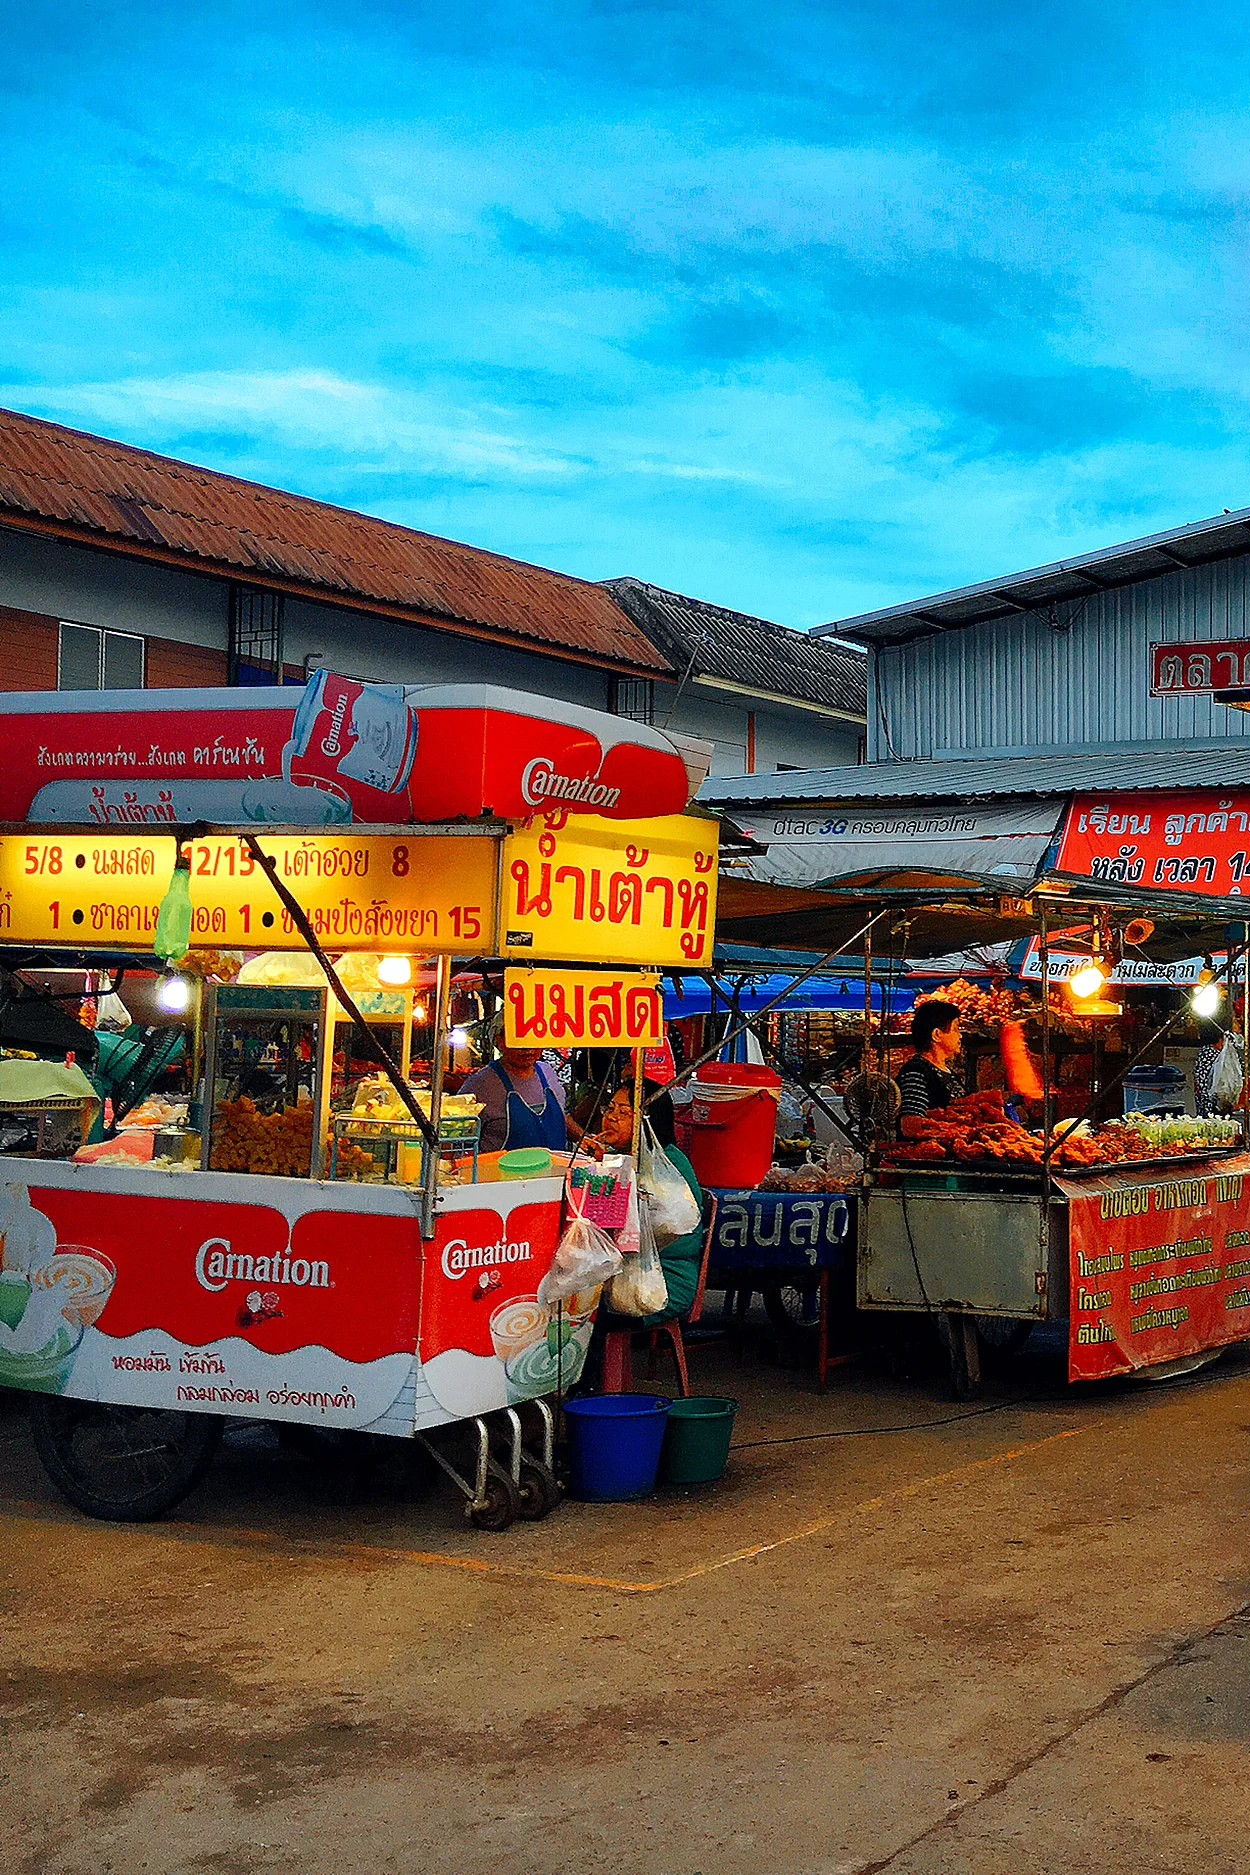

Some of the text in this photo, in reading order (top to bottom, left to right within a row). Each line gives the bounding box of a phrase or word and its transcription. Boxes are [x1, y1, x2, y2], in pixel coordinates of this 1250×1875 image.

[320, 693, 348, 757] Carnation
[521, 757, 621, 808] Carnation
[773, 817, 818, 836] dtac
[819, 818, 848, 835] 3G
[1078, 805, 1150, 835] เรียน
[25, 846, 63, 875] 5/8
[92, 847, 156, 875] นมสด
[284, 841, 369, 877] เต้าฮวย
[391, 845, 410, 877] 8
[1153, 857, 1215, 882] เวลา
[511, 806, 714, 959] น้ำเต้าหู้
[48, 901, 60, 929] 1
[238, 903, 251, 933] 1
[447, 906, 481, 939] 15
[508, 980, 659, 1039] นมสด
[195, 1237, 329, 1292] Carnation
[441, 1239, 531, 1280] Carnation
[112, 1351, 171, 1372] หอมมัน
[177, 1380, 356, 1414] กลมกล่อม อร่อยทุกคำ
